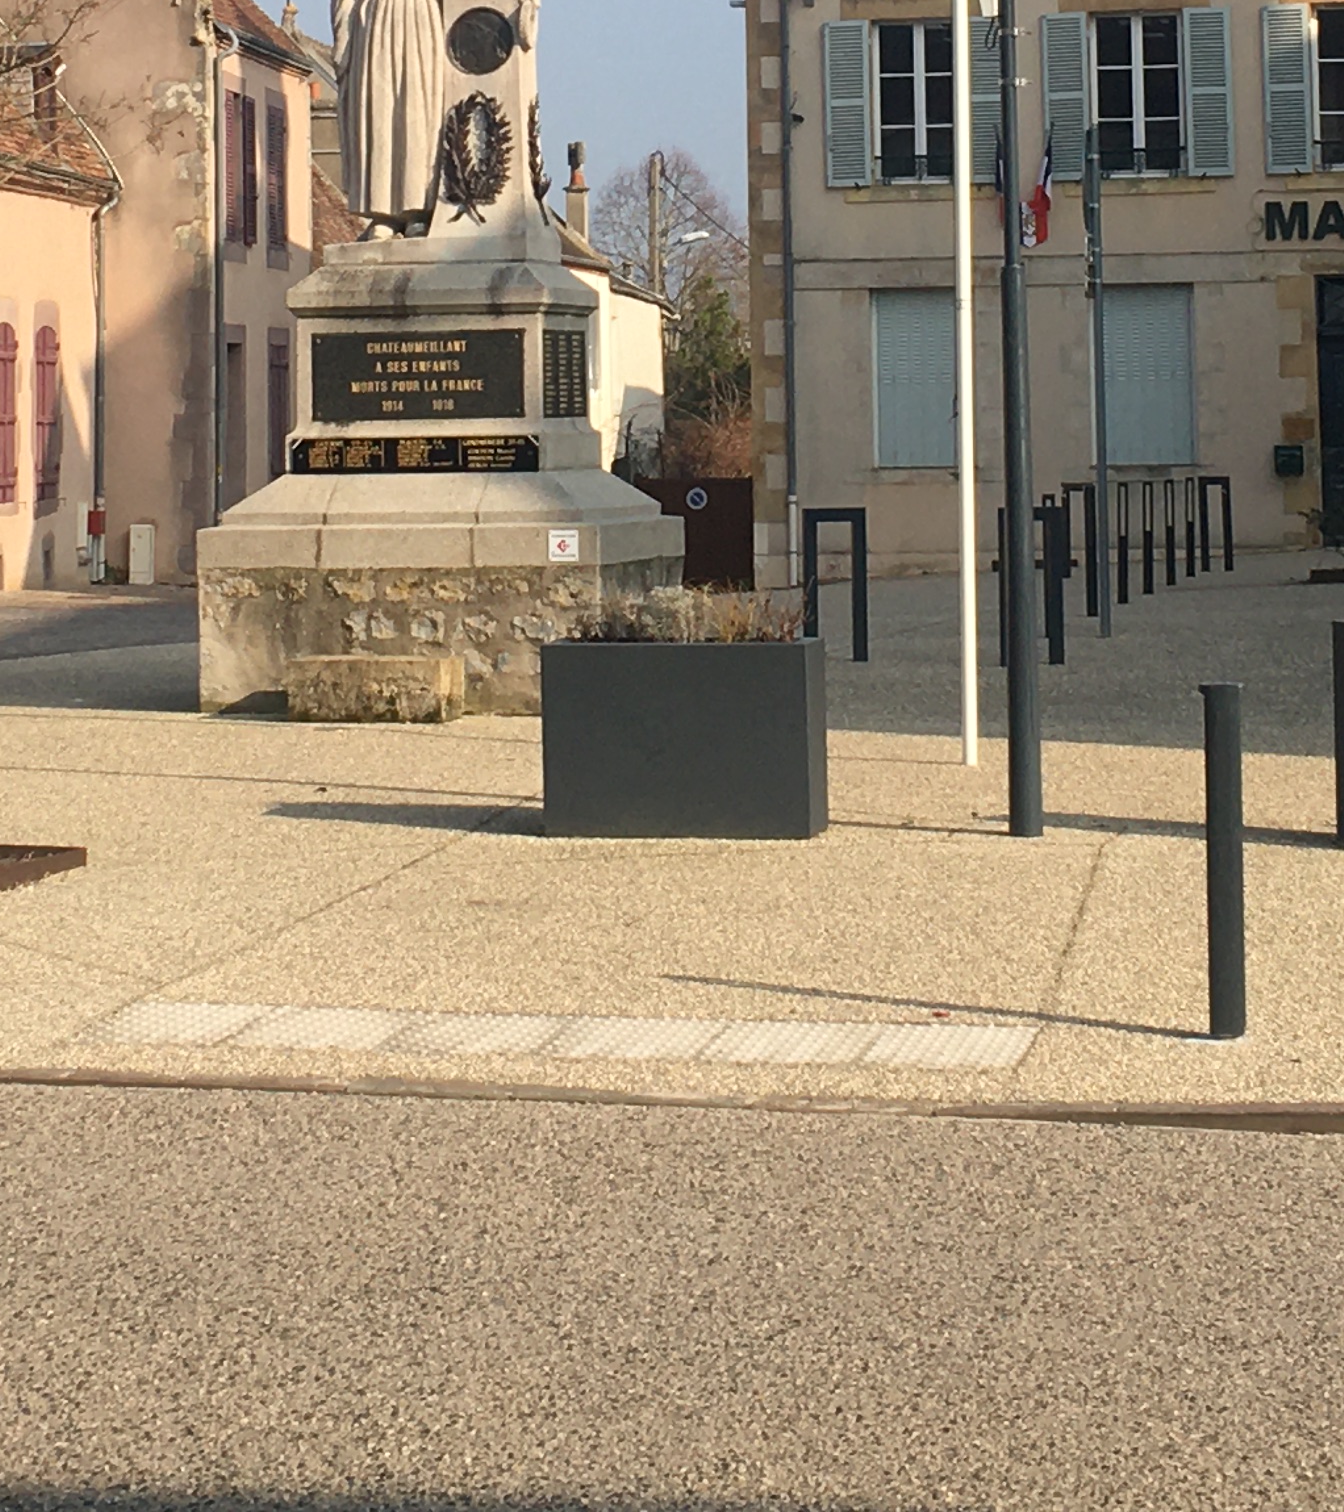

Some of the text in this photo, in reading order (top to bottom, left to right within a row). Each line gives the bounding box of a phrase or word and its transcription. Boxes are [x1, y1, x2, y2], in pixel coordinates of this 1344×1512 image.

[366, 340, 467, 354] CHATEAUMEILLANT
[375, 360, 460, 372] A SES ENFANTS
[351, 379, 484, 393] MORTS POUR LA FRANCE
[382, 400, 403, 411] 1914
